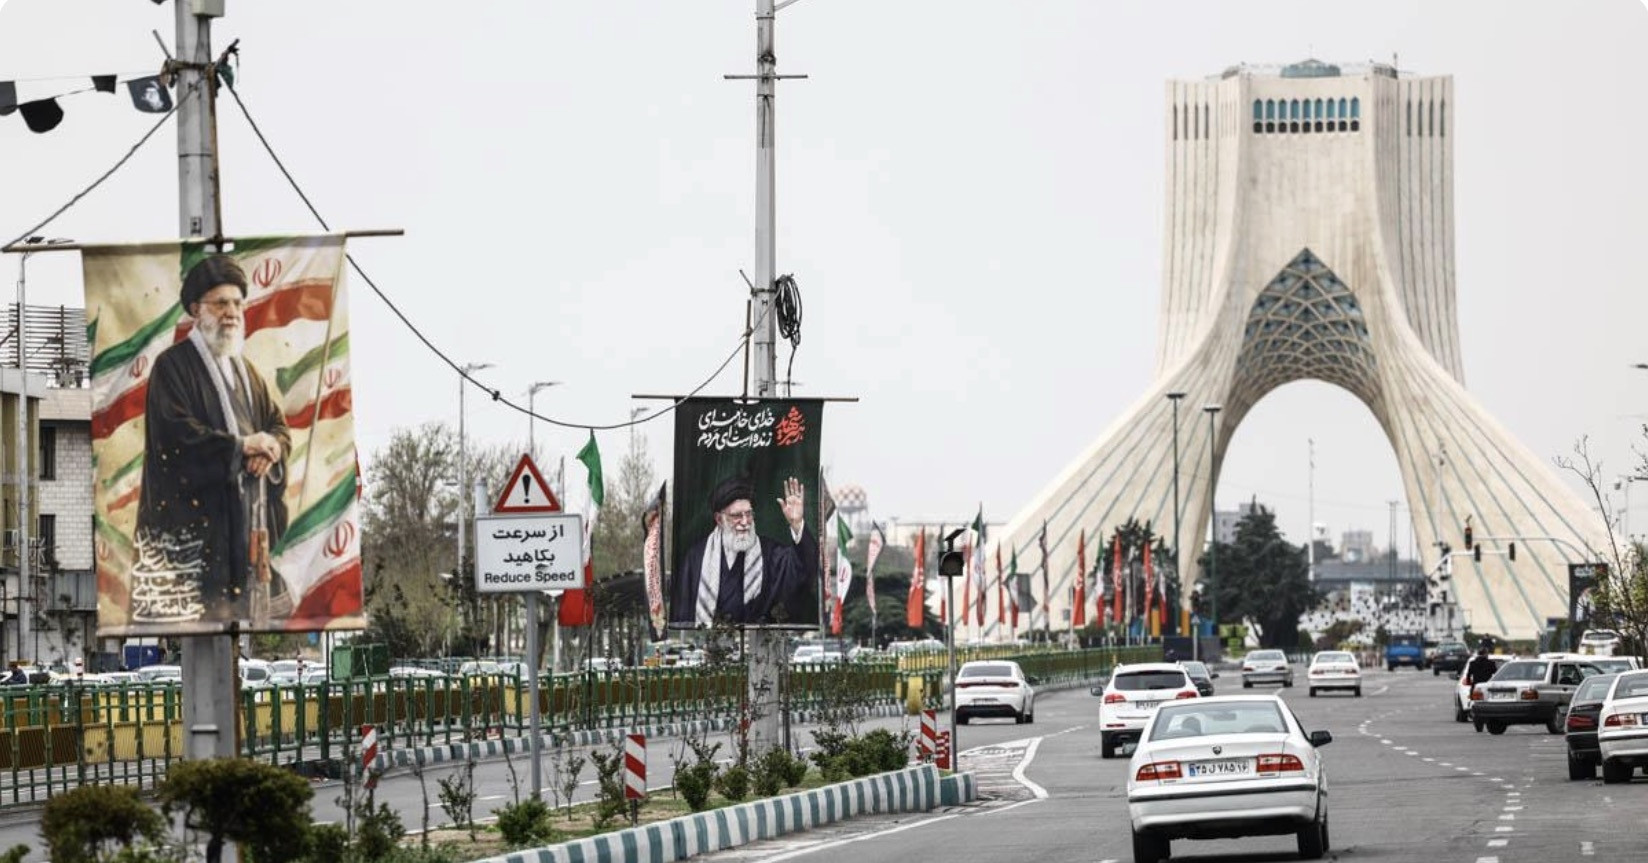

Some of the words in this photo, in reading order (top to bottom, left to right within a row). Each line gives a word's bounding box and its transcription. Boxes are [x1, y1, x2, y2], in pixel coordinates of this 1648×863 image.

[753, 431, 773, 448] زنده
[492, 528, 547, 543] سرعت
[549, 524, 564, 543] از
[503, 549, 556, 567] بکاهید
[484, 573, 532, 583] Reduce
[535, 570, 576, 583] Speed
